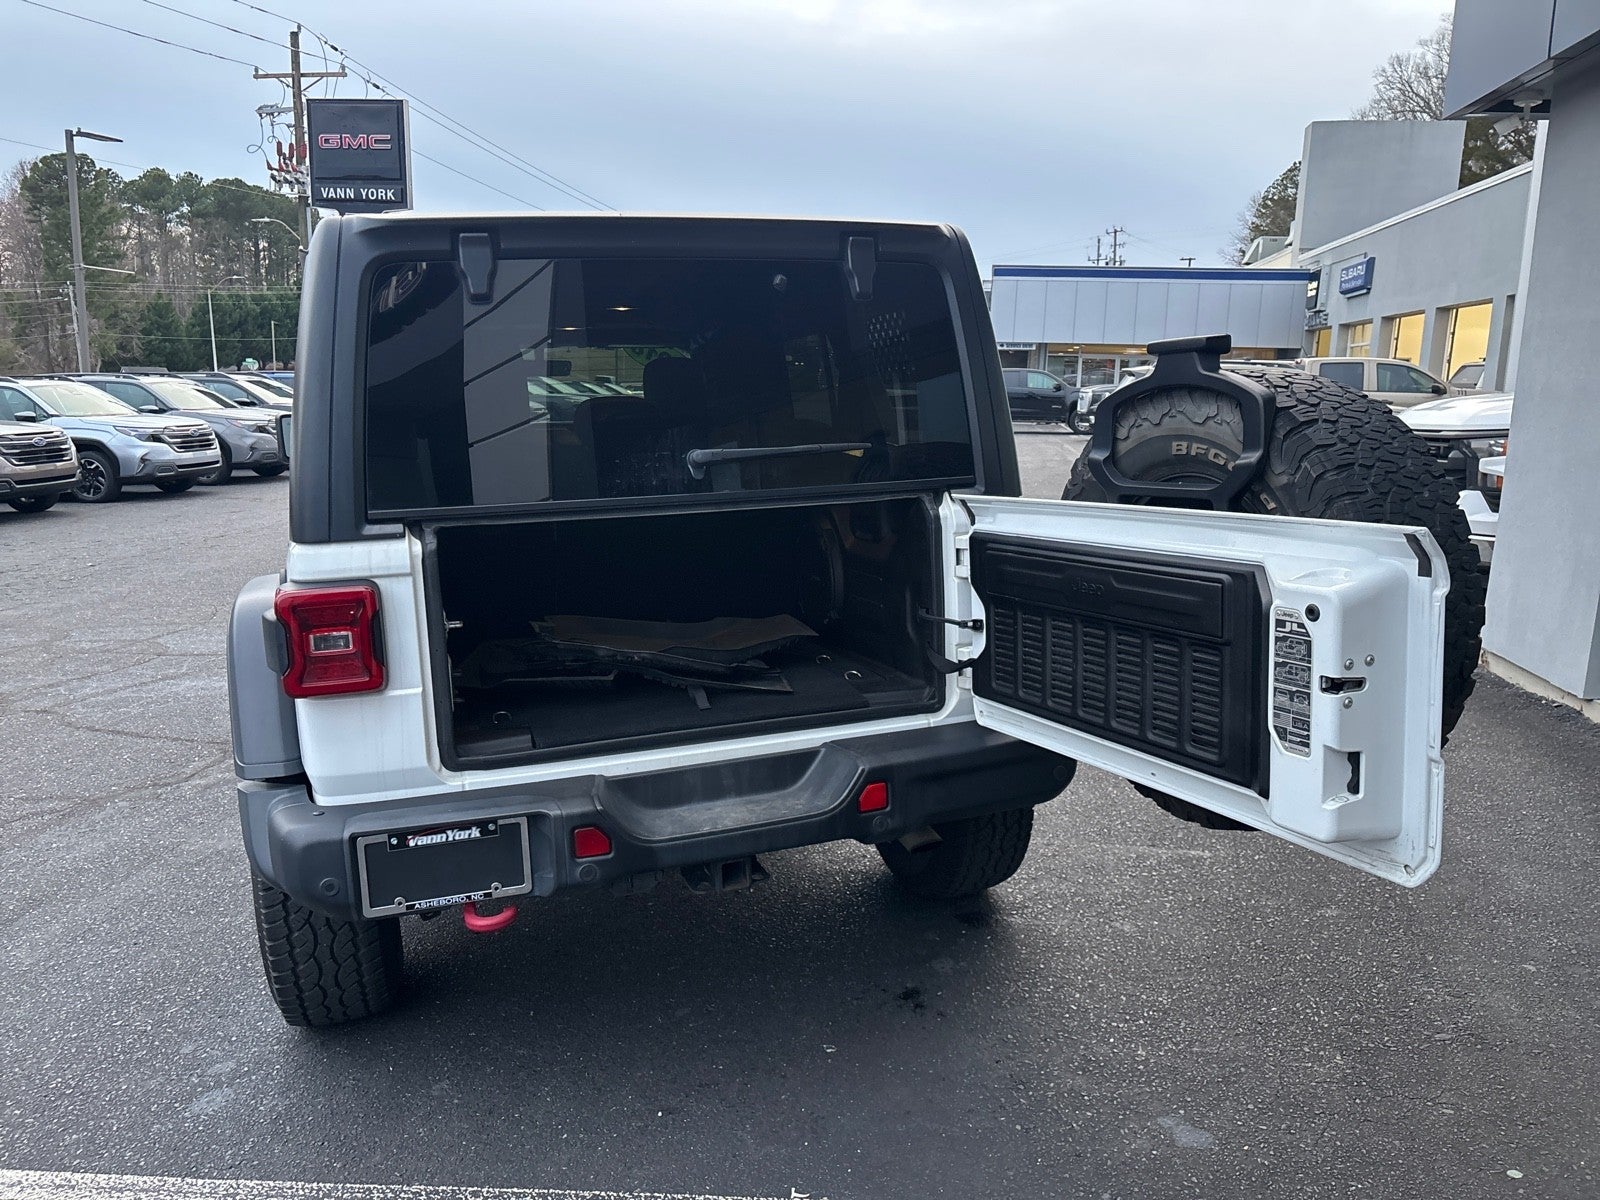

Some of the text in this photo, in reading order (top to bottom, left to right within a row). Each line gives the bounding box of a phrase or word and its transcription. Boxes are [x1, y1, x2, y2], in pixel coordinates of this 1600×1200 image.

[318, 134, 392, 150] GMC
[320, 187, 396, 200] VANN YORK
[1341, 264, 1366, 281] SUBARU
[414, 893, 485, 910] ASHEBORO, NC
